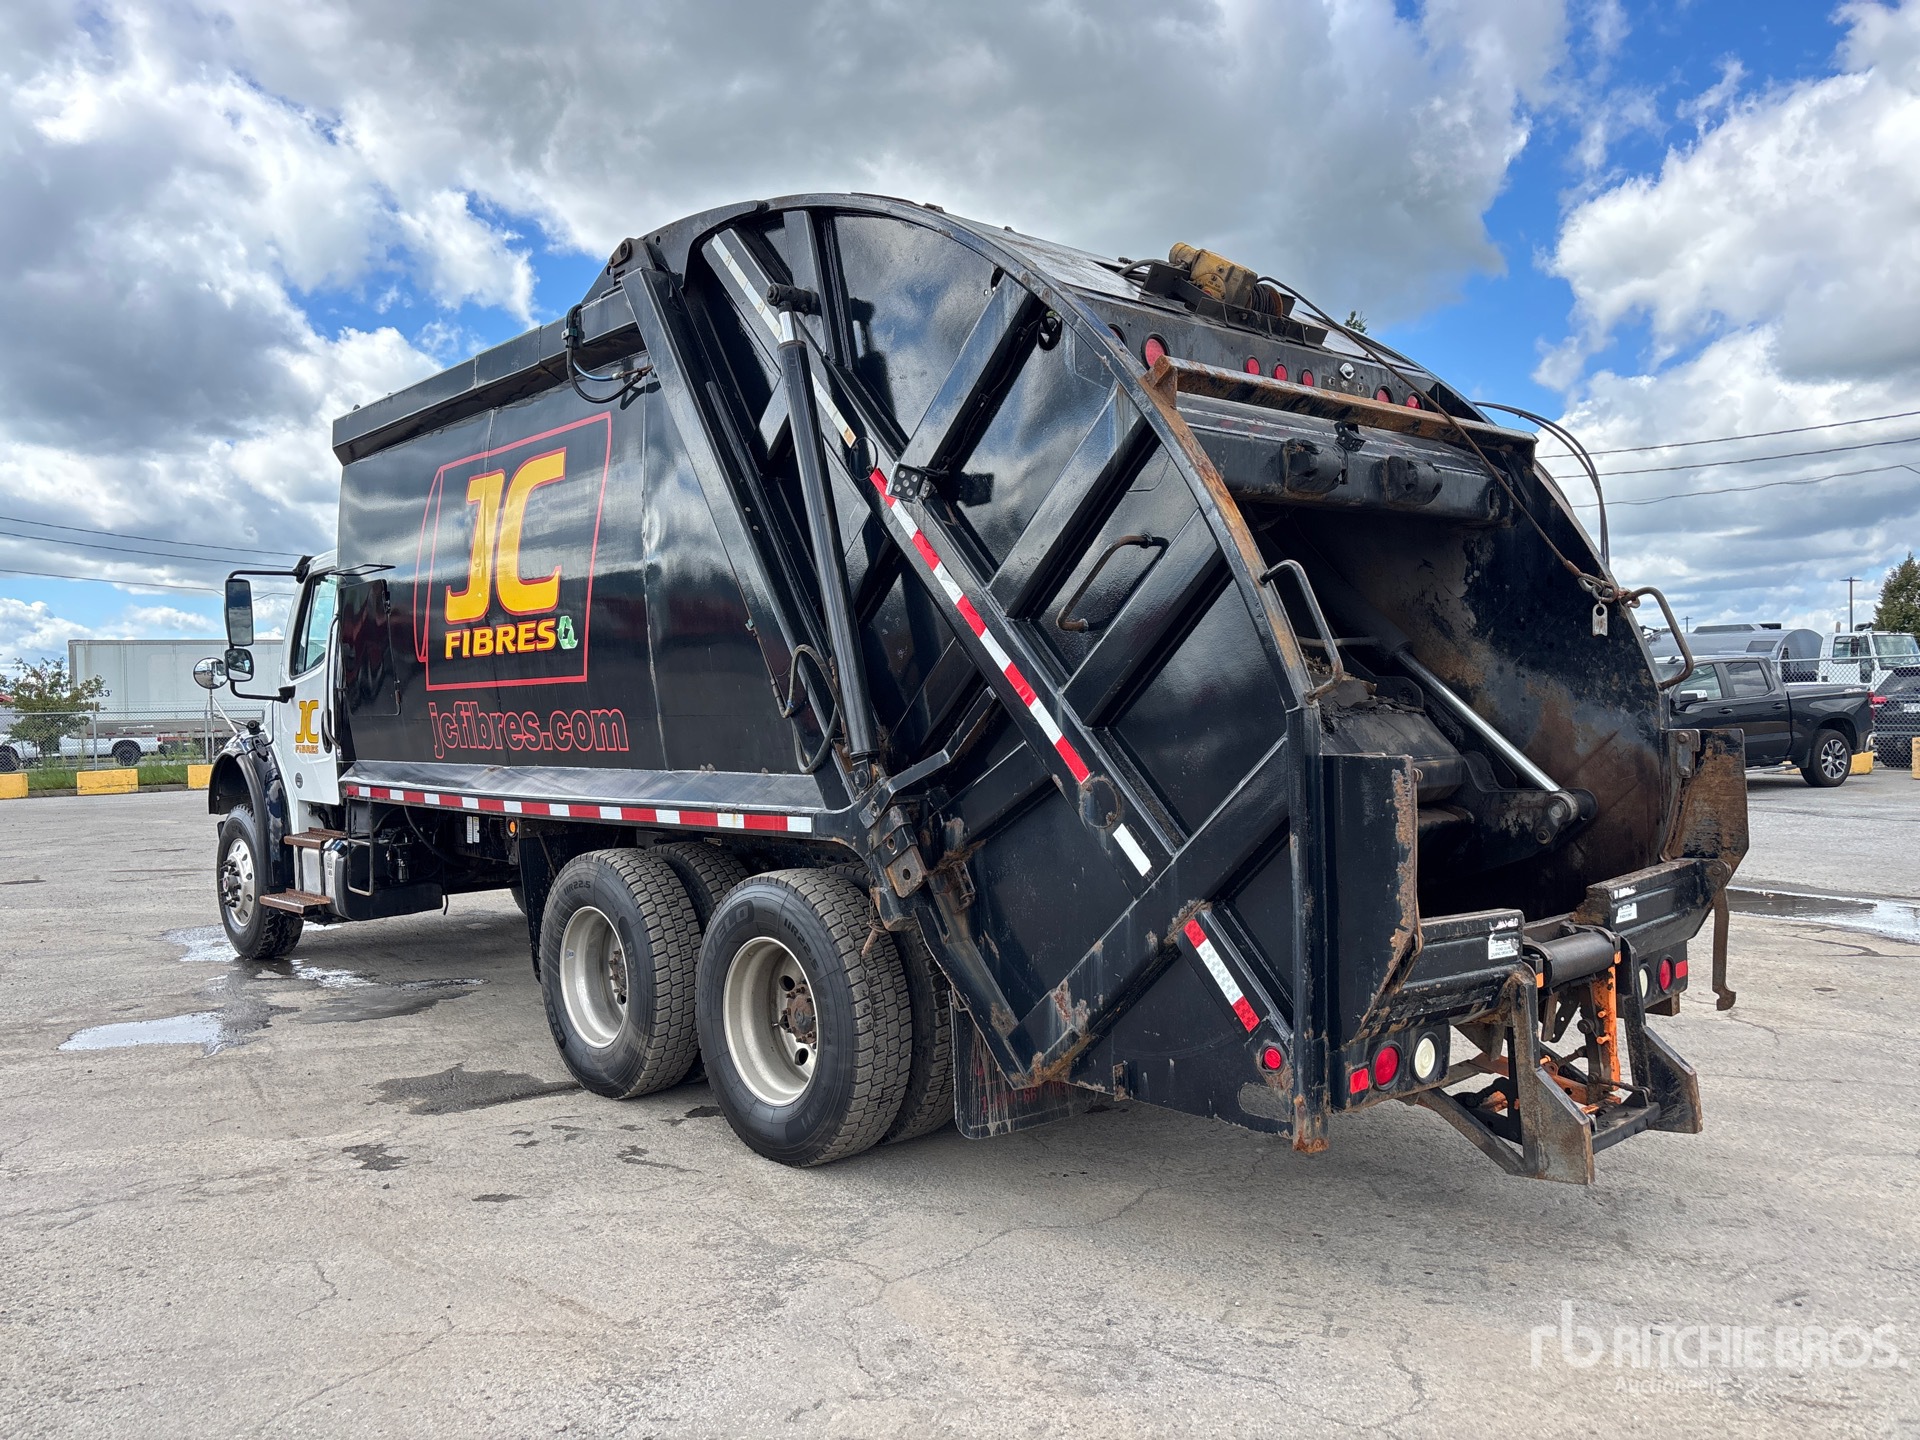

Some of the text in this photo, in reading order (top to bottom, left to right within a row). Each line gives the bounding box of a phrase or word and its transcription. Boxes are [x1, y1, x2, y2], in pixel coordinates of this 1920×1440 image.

[445, 447, 566, 623] JC
[445, 616, 557, 660] FIBRES
[295, 699, 319, 743] JC
[428, 701, 630, 759] jcfibres.com
[295, 744, 319, 755] FIBRES
